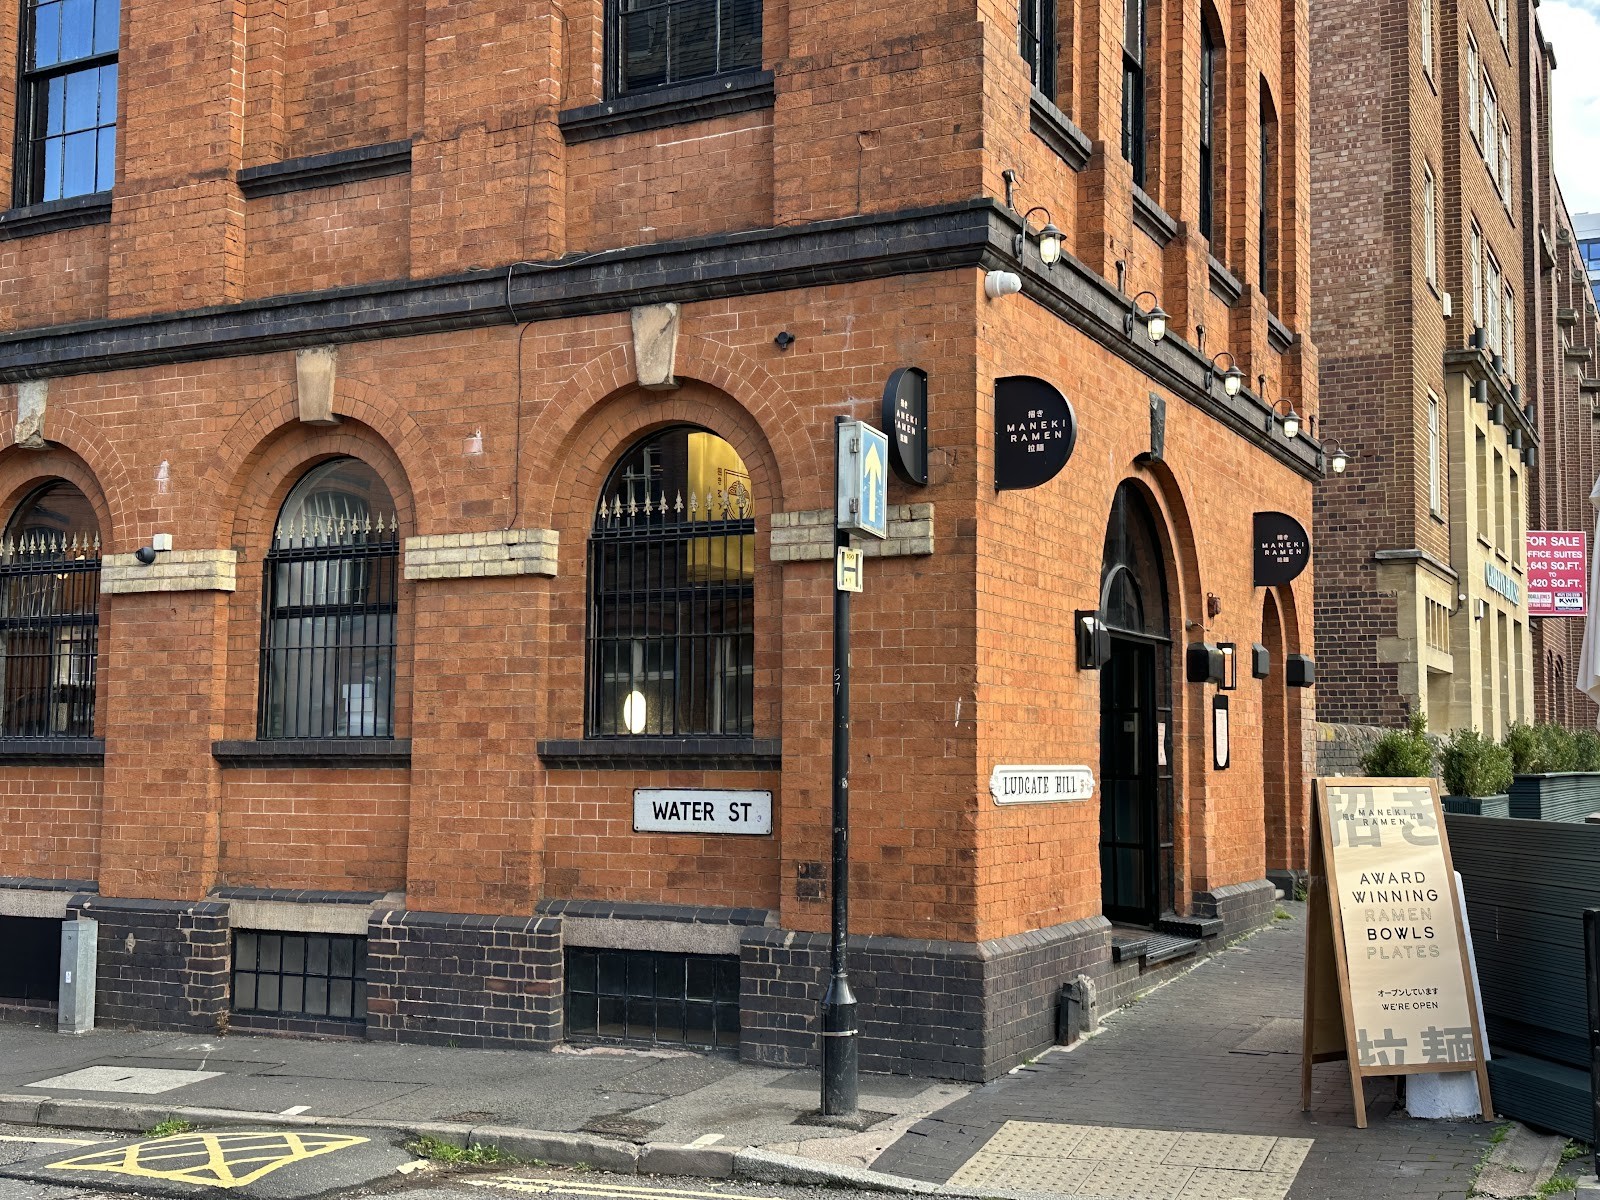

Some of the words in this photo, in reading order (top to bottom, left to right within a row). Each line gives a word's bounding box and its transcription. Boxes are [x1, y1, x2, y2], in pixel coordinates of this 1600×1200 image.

[897, 410, 918, 425] ANEKI
[895, 419, 916, 435] AMEN
[1007, 420, 1065, 432] MANEKI
[1011, 431, 1062, 442] RAMEN
[1550, 537, 1580, 547] SALE
[1527, 562, 1548, 571] ,643
[1551, 562, 1582, 571] SQ.FT.
[1551, 579, 1582, 588] SQ.FT.
[1003, 776, 1049, 796] LUDGATE
[1055, 776, 1077, 793] HILL
[652, 801, 715, 821] WATER
[729, 802, 752, 822] ST
[1363, 818, 1406, 826] RAMEN
[1360, 871, 1426, 885] AWARD
[1352, 889, 1438, 903] WINNING
[1365, 907, 1432, 922] RAMEN
[1367, 926, 1435, 940] BOWLS
[1367, 944, 1440, 960] PLATES
[1413, 1002, 1438, 1010] OPEN
